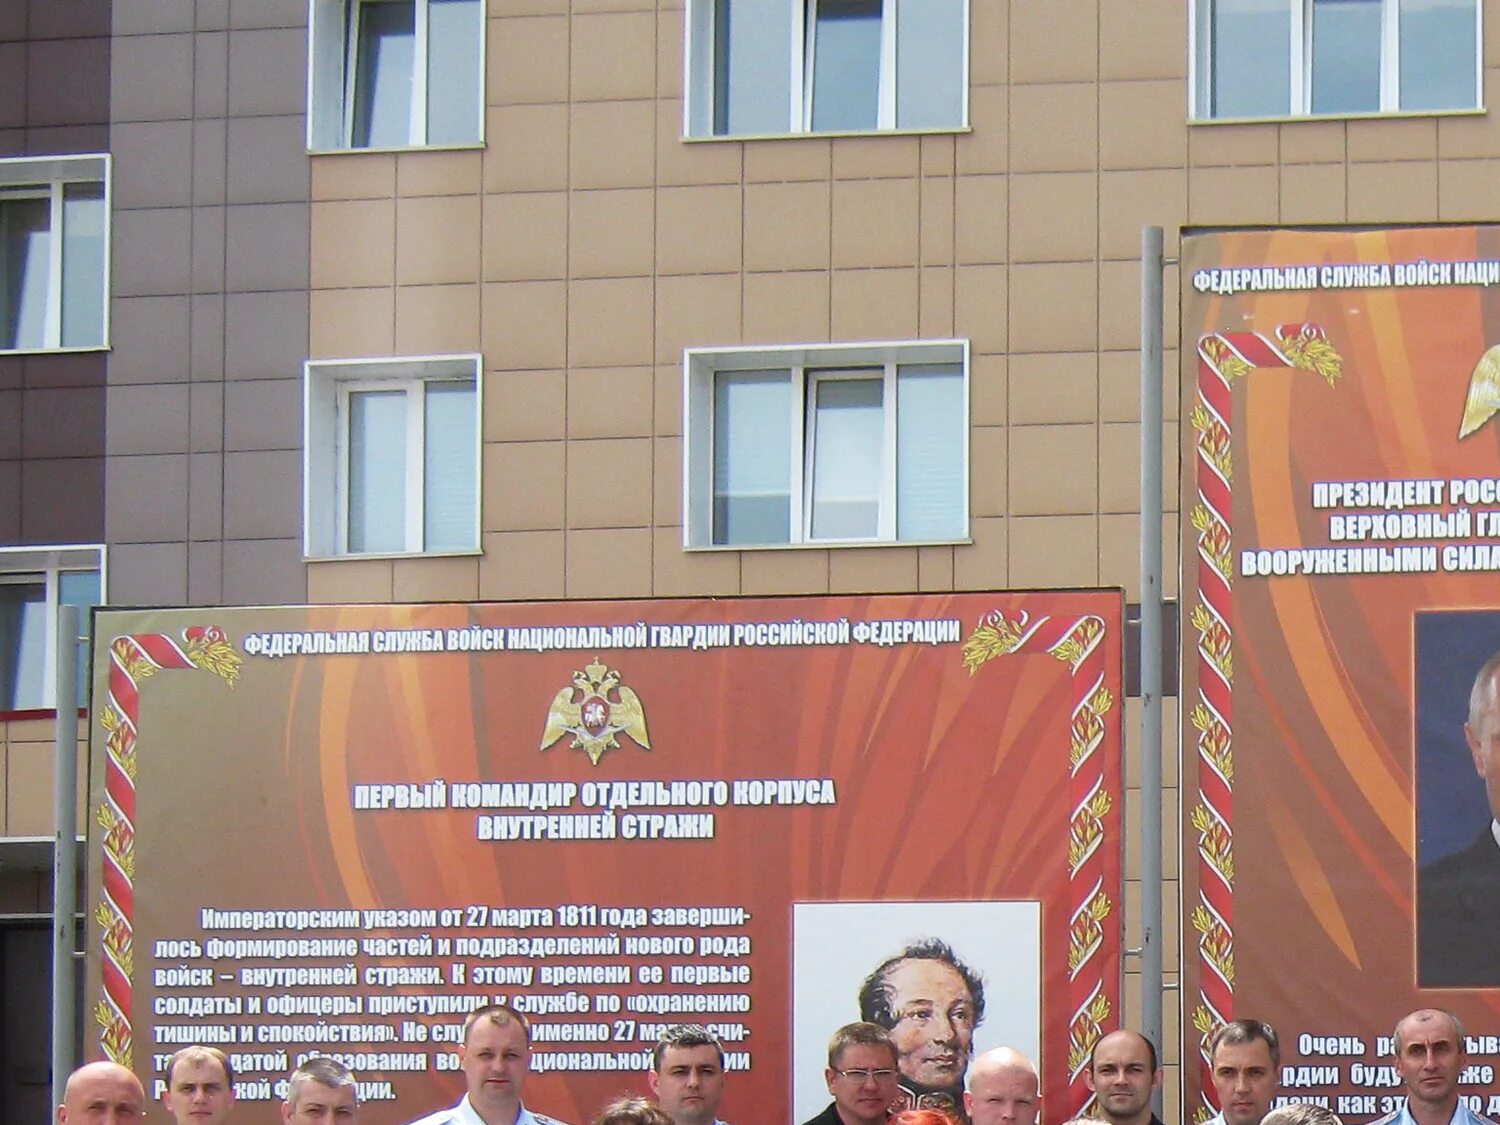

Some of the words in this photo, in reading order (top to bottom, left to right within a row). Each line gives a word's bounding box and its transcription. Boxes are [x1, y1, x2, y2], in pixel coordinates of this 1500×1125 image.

[1190, 262, 1318, 295] ФЕДЕРАЛЬНАЯ
[1317, 261, 1393, 288] СЛУЖБА
[1394, 259, 1452, 286] ВОЙСК
[1313, 479, 1445, 510] ПРЕЗИДЕНТ
[1330, 506, 1471, 541] ВЕРХОВНЫЙ
[1241, 546, 1437, 576] ВООРУЖЕННЫМИ
[243, 631, 371, 658] ФЕДЕРАЛЬНАЯ
[372, 628, 445, 654] СЛУЖБА
[446, 624, 505, 651] ВОЙСК
[507, 623, 648, 653] НАЦИОНАЛЬНОЙ
[650, 624, 731, 650] ГВАРДИИ
[733, 617, 850, 646] РОССИЙСКОЙ
[852, 619, 961, 647] ФЕДЕРАЦИИ
[354, 778, 447, 809] ПЕРВЫЙ
[451, 782, 577, 811] КОМАНДИР
[581, 780, 728, 809] ОТДЕЛЬНОГО
[733, 779, 836, 805] КОРПУСА
[477, 809, 616, 840] ВНУТРЕННЕЙ
[621, 813, 714, 839] СТРАЖИ
[201, 908, 360, 931] Императорским
[360, 907, 437, 930] указом
[440, 909, 464, 927] от
[466, 905, 488, 927] 27
[491, 908, 553, 929] марта
[556, 904, 597, 927] 1811
[600, 908, 648, 929] года
[651, 907, 751, 928] заверши-
[154, 940, 202, 958] лось
[206, 937, 358, 960] формирование
[362, 934, 433, 956] частей
[437, 938, 451, 956] и
[455, 932, 620, 959] подразделений
[625, 936, 695, 955] нового
[699, 936, 751, 958] рода
[154, 964, 213, 987] войск
[241, 963, 357, 988] внутренней
[364, 967, 445, 987] стражи.
[451, 963, 465, 985] К
[472, 966, 534, 986] этому
[540, 965, 631, 986] времени
[638, 965, 663, 984] ее
[670, 965, 750, 986] первые
[154, 996, 242, 1018] солдаты
[247, 996, 261, 1014] и
[266, 994, 363, 1017] офицеры
[367, 995, 489, 1015] приступили
[512, 991, 590, 1015] службе
[595, 994, 621, 1013] по
[626, 994, 751, 1015] «охранению
[153, 1025, 237, 1043] тишины
[240, 1025, 254, 1043] и
[257, 1020, 399, 1043] спокойствия».
[402, 1021, 429, 1042] Не
[530, 1022, 610, 1042] именно
[613, 1019, 636, 1042] 27
[1298, 1033, 1366, 1057] Очень
[230, 1048, 289, 1074] датой
[1349, 1063, 1403, 1088] буду
[1337, 1094, 1377, 1115] как
